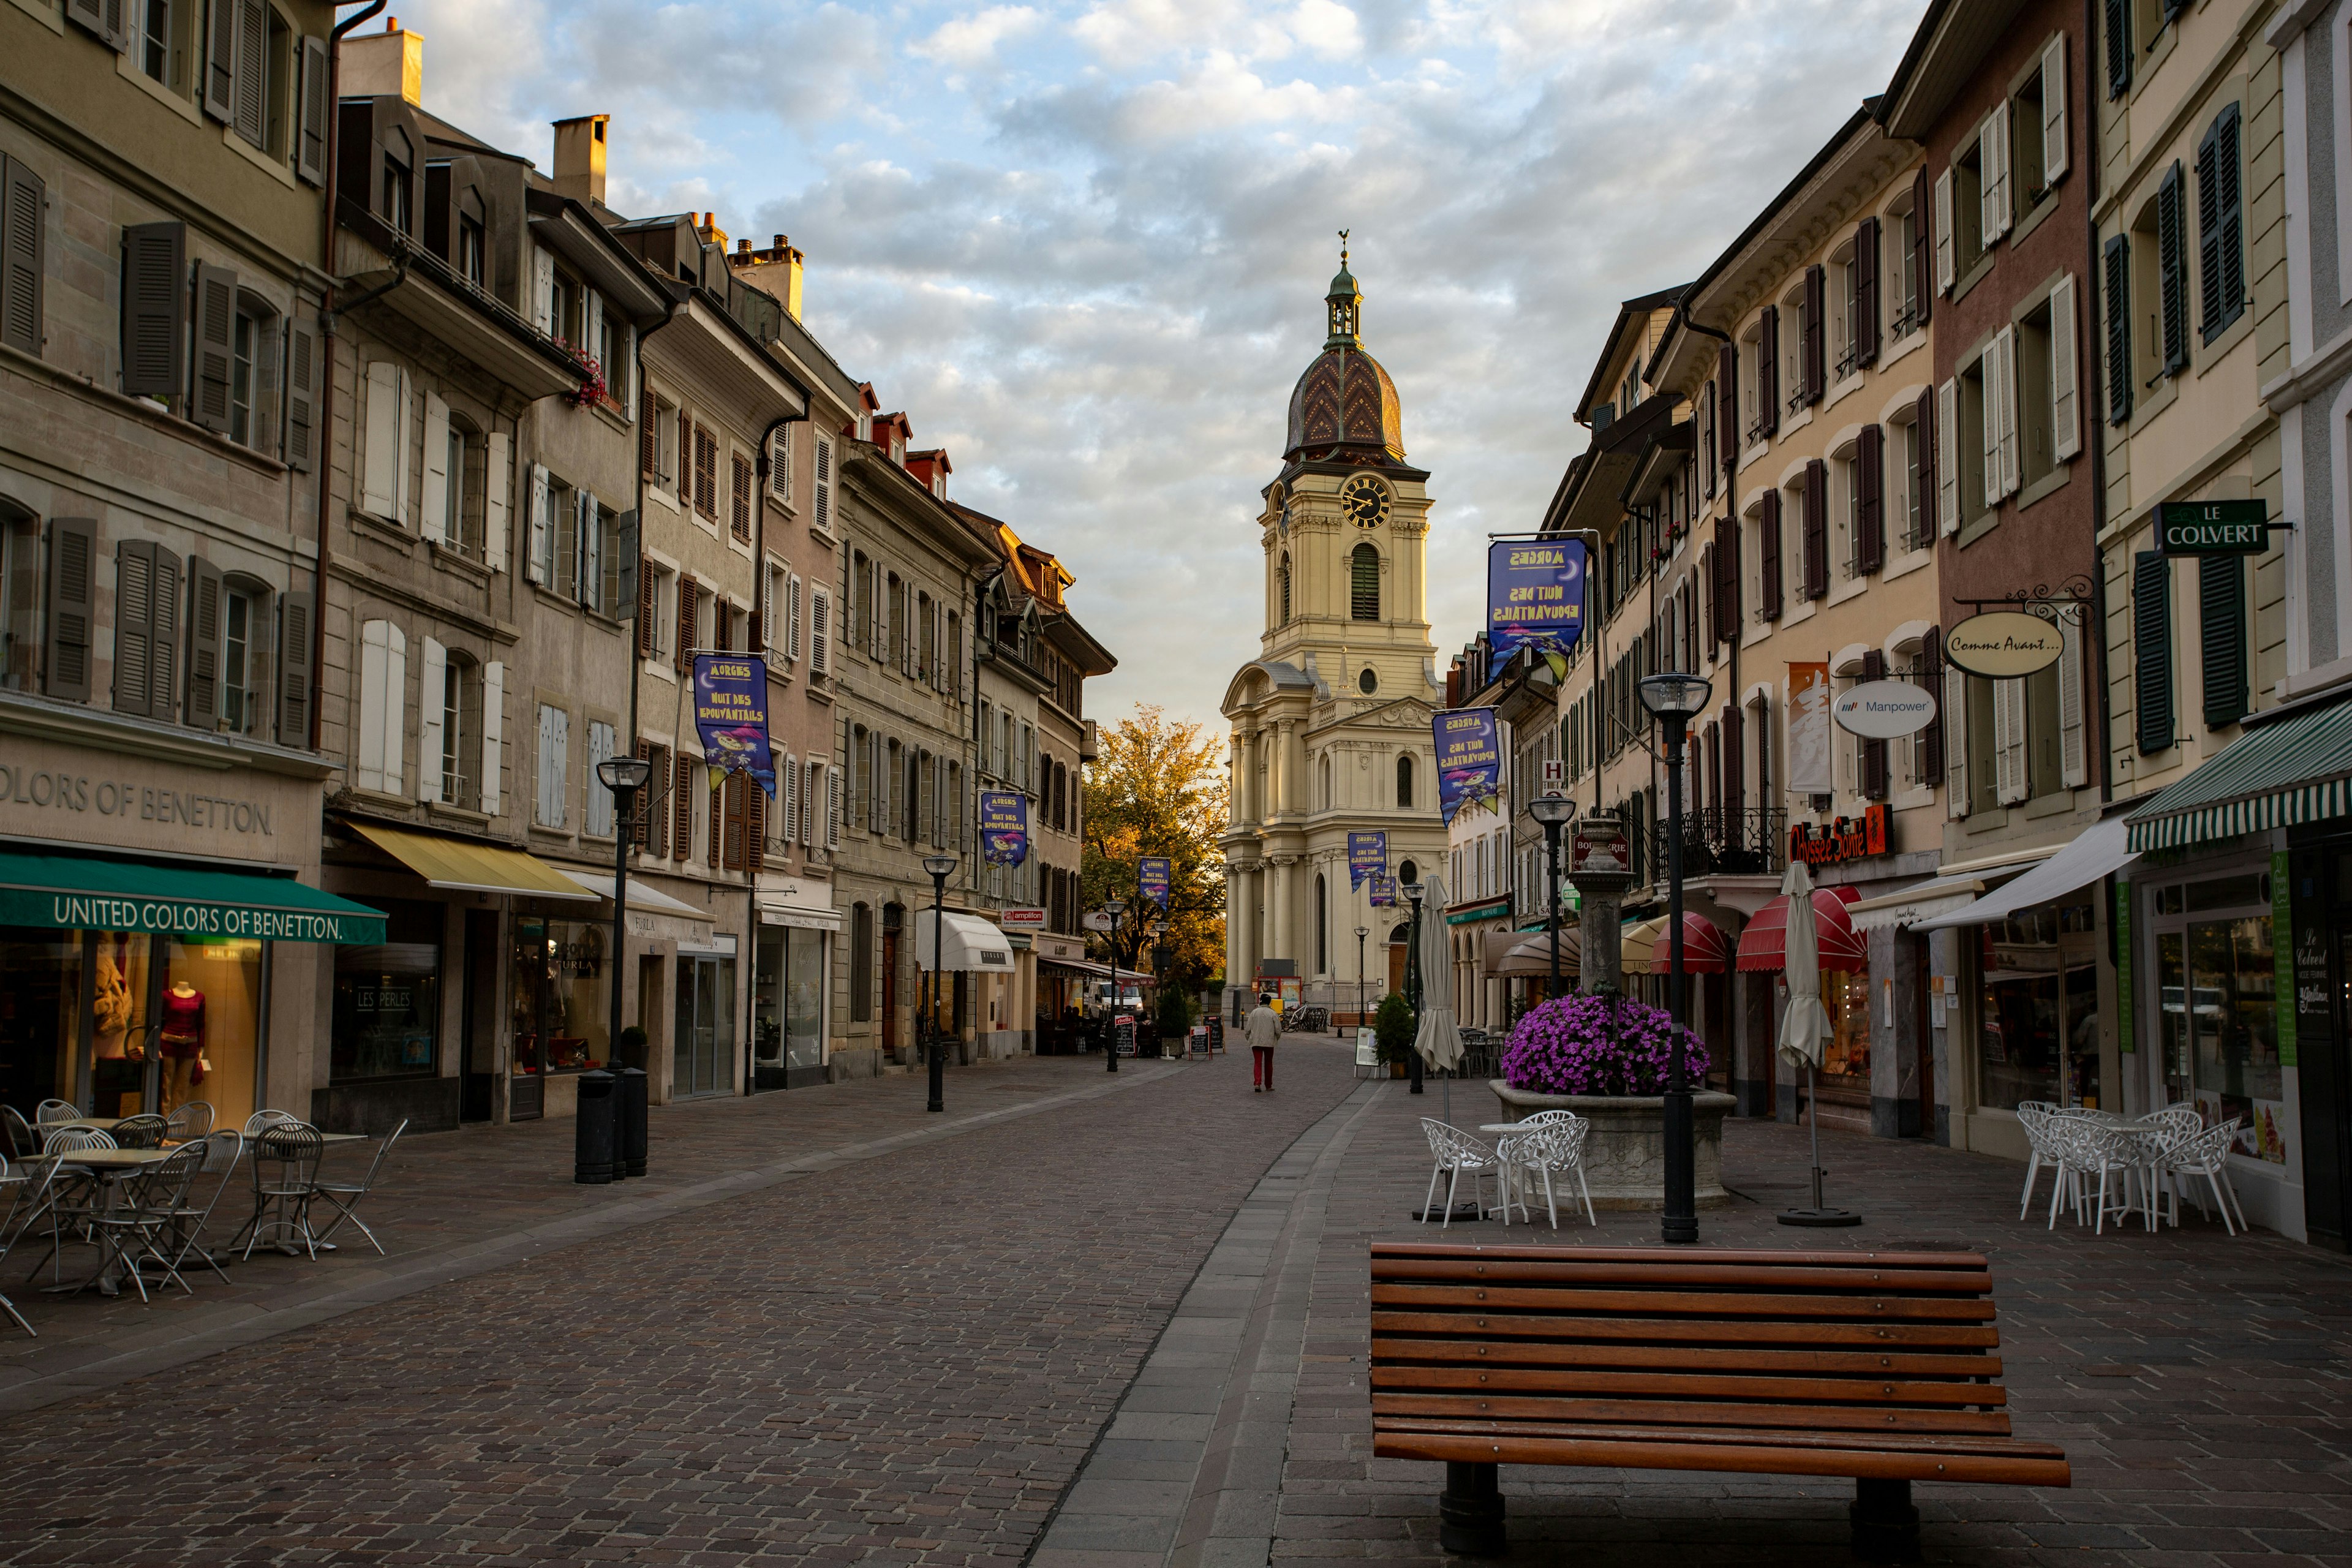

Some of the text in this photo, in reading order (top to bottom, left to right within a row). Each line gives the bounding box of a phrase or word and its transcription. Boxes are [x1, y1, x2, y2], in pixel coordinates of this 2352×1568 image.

[2204, 507, 2220, 520] LE
[2167, 524, 2261, 545] COLVERT
[1951, 637, 2001, 651] Comme
[710, 665, 751, 677] MORGES
[711, 692, 752, 706] NUIT DES
[699, 707, 764, 722] EPOUVANTAILS
[1866, 701, 1928, 714] Manpower
[96, 780, 134, 816] OF
[985, 822, 1024, 831] EPOUVANTAILS
[1834, 816, 1865, 862] Santé
[55, 897, 342, 940] UNITED COLORS OF BENETTON.
[636, 918, 655, 931] FURLA
[2305, 928, 2316, 946] Le
[2296, 948, 2327, 965] Colvert
[358, 992, 410, 1007] LES PERLES
